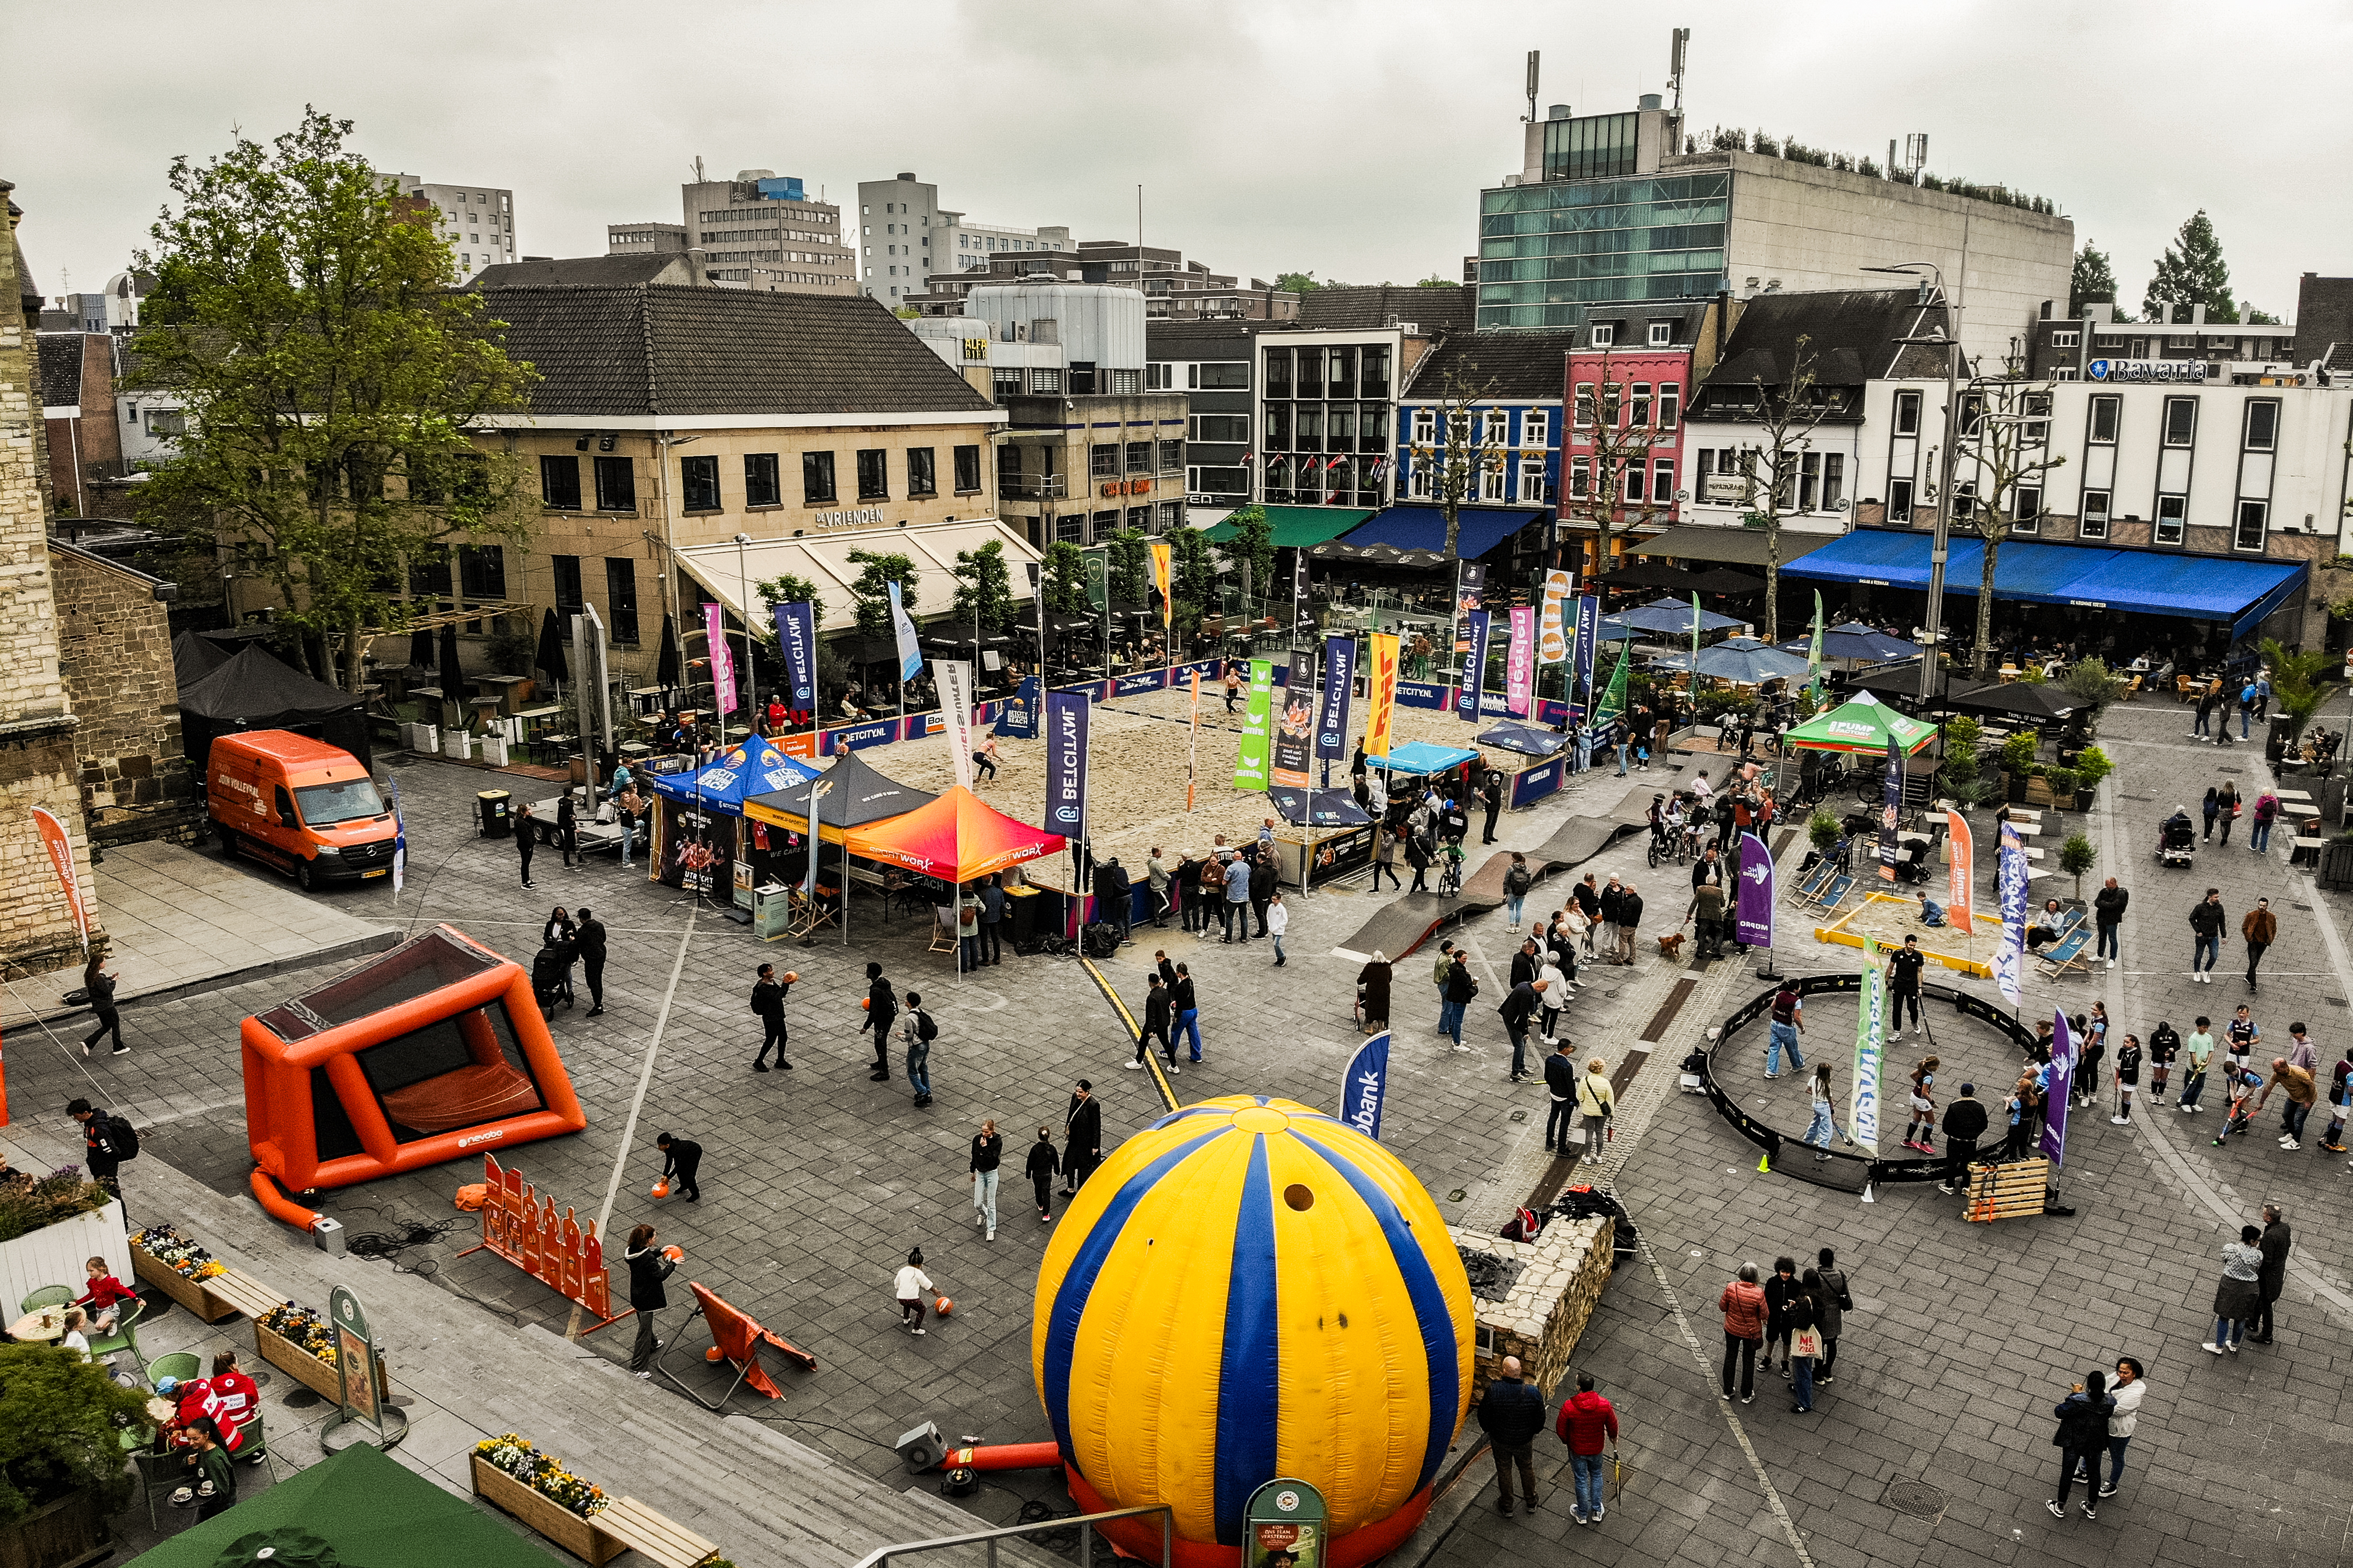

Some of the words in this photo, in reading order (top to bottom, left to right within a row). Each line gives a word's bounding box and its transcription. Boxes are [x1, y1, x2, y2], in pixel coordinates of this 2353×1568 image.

[965, 339, 986, 349] ALFA
[966, 350, 986, 359] BIER
[2114, 358, 2208, 381] Bavaria
[816, 513, 825, 522] DE
[825, 508, 883, 527] VRIENDEN
[1298, 619, 1315, 627] STAR
[1835, 728, 1871, 737] FACTORY
[1837, 721, 1876, 733] PUMP
[762, 767, 800, 781] BETCITY
[1527, 767, 1550, 785] HEERLEN
[770, 850, 782, 859] WE
[783, 847, 802, 856] CARE
[684, 870, 714, 884] UTRCHT
[467, 1129, 503, 1143] nevobo
